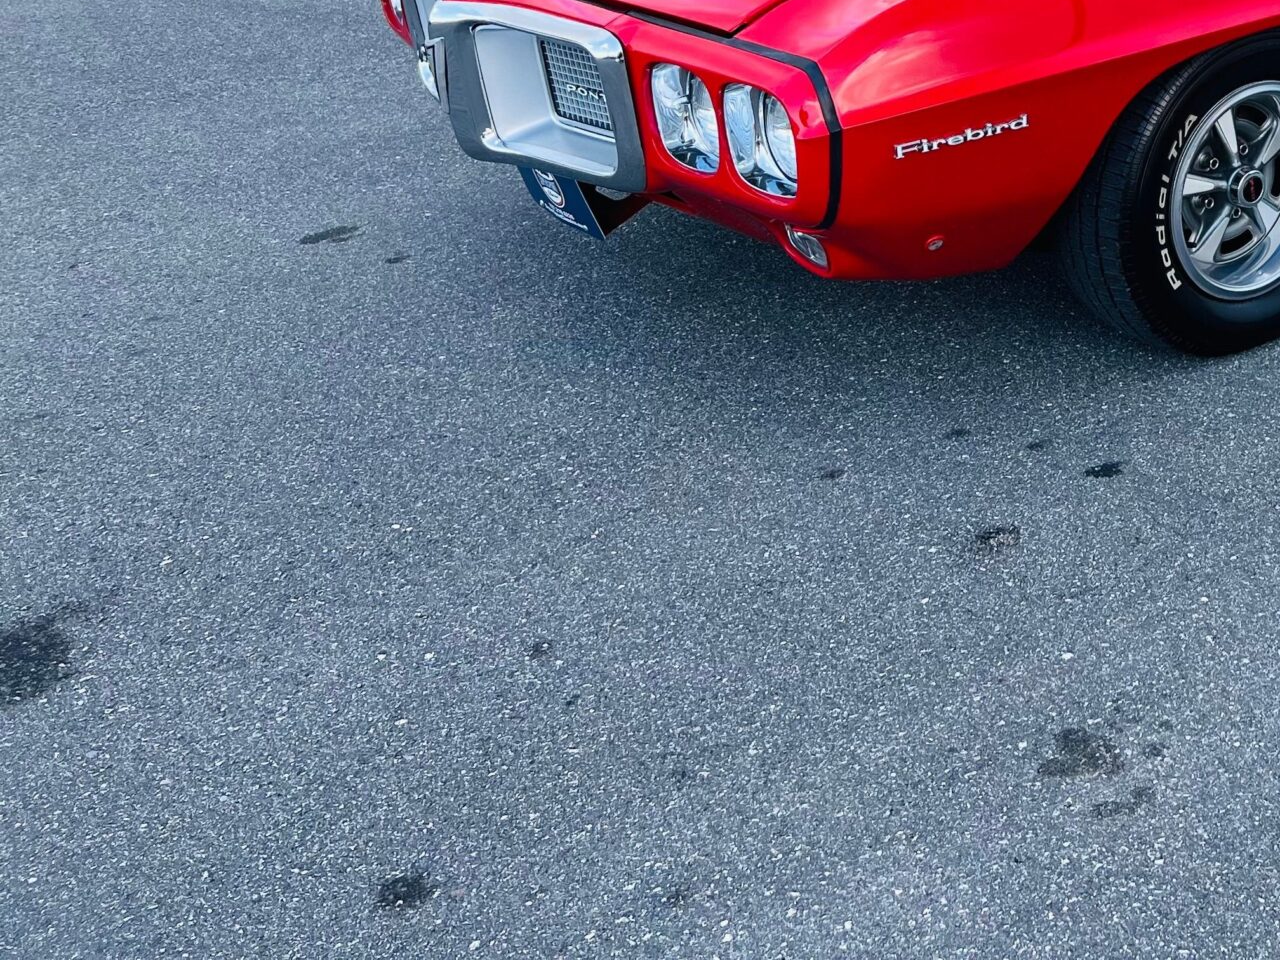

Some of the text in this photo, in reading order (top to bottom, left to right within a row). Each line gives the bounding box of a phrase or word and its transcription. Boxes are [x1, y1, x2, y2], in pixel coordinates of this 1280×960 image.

[893, 113, 1030, 160] Firebird
[1155, 113, 1199, 291] Radial T/A
